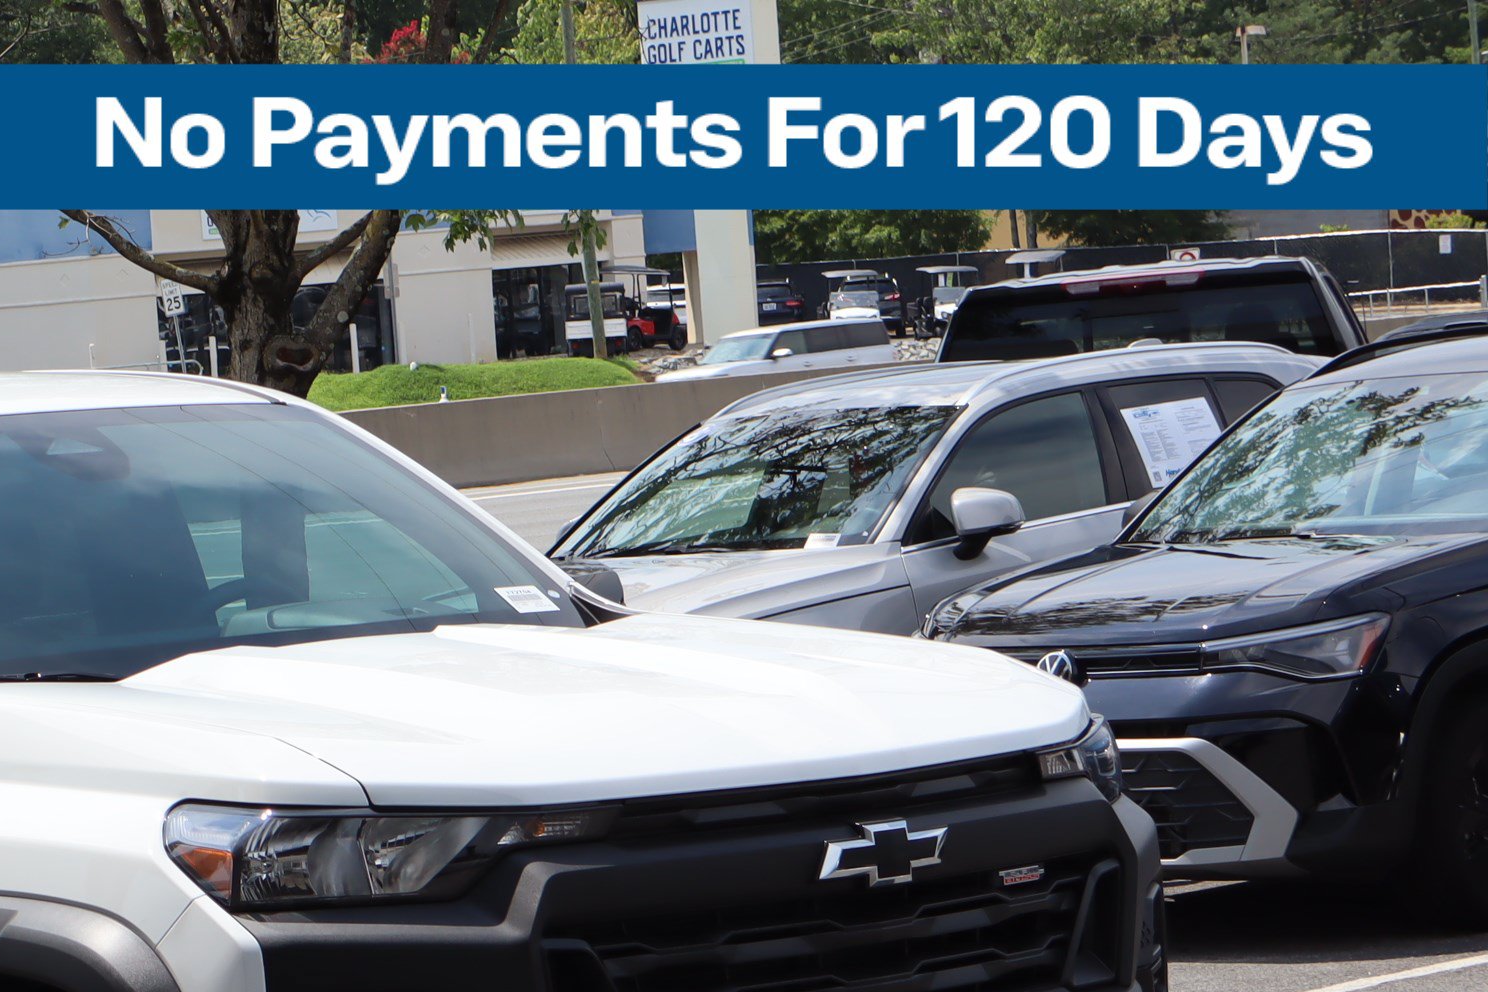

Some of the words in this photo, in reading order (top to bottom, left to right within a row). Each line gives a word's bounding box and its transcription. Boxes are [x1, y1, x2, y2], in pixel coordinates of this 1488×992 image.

[647, 9, 741, 39] CHARLOTTE
[647, 41, 686, 64] GOLF
[693, 34, 745, 60] CARTS
[166, 295, 181, 311] 25
